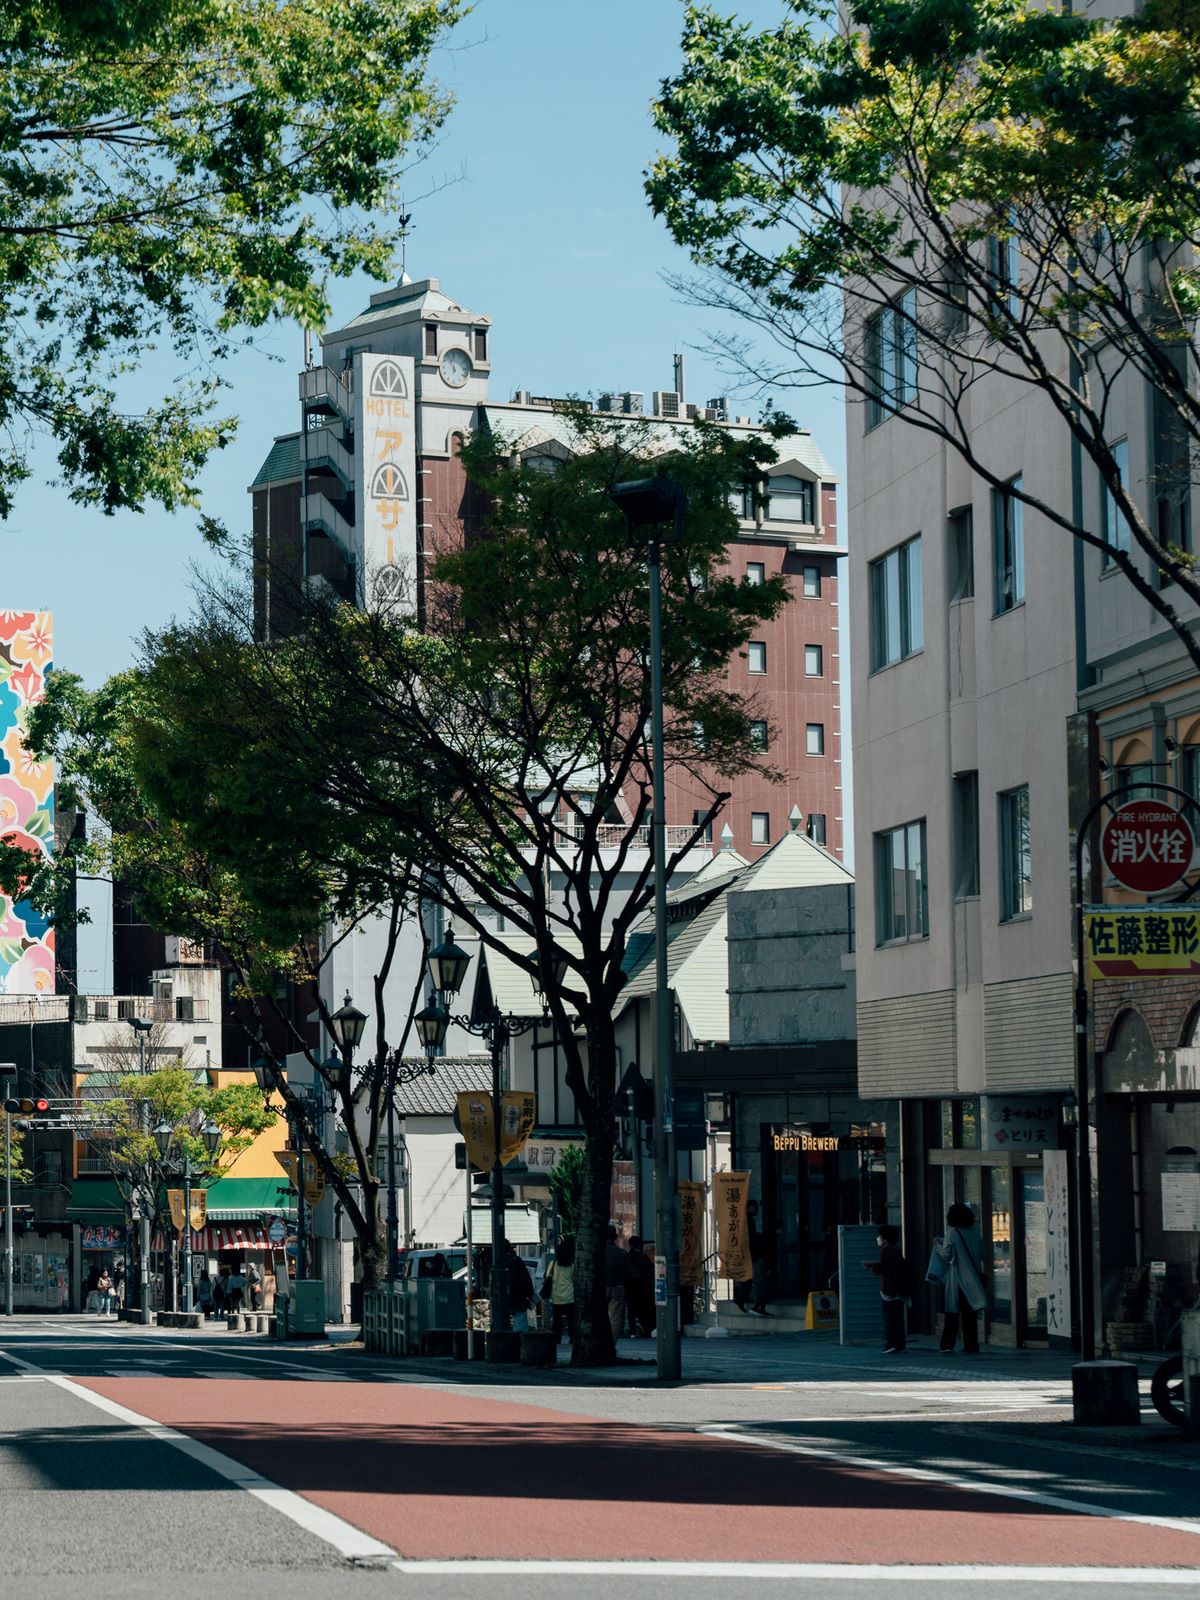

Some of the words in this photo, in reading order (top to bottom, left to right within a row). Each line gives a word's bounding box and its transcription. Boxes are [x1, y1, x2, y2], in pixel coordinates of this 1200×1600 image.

[366, 401, 410, 418] HOTEL
[375, 430, 405, 563] アーサー
[1117, 813, 1136, 822] FIRE
[1138, 813, 1178, 822] HYDRANT
[1110, 828, 1188, 864] 消火栓
[1088, 914, 1199, 956] 佐藤整形
[773, 1135, 800, 1151] BEPPU
[801, 1135, 839, 1151] BREWERY
[1011, 1129, 1049, 1143] とり天
[726, 1188, 741, 1247] 湯あがり
